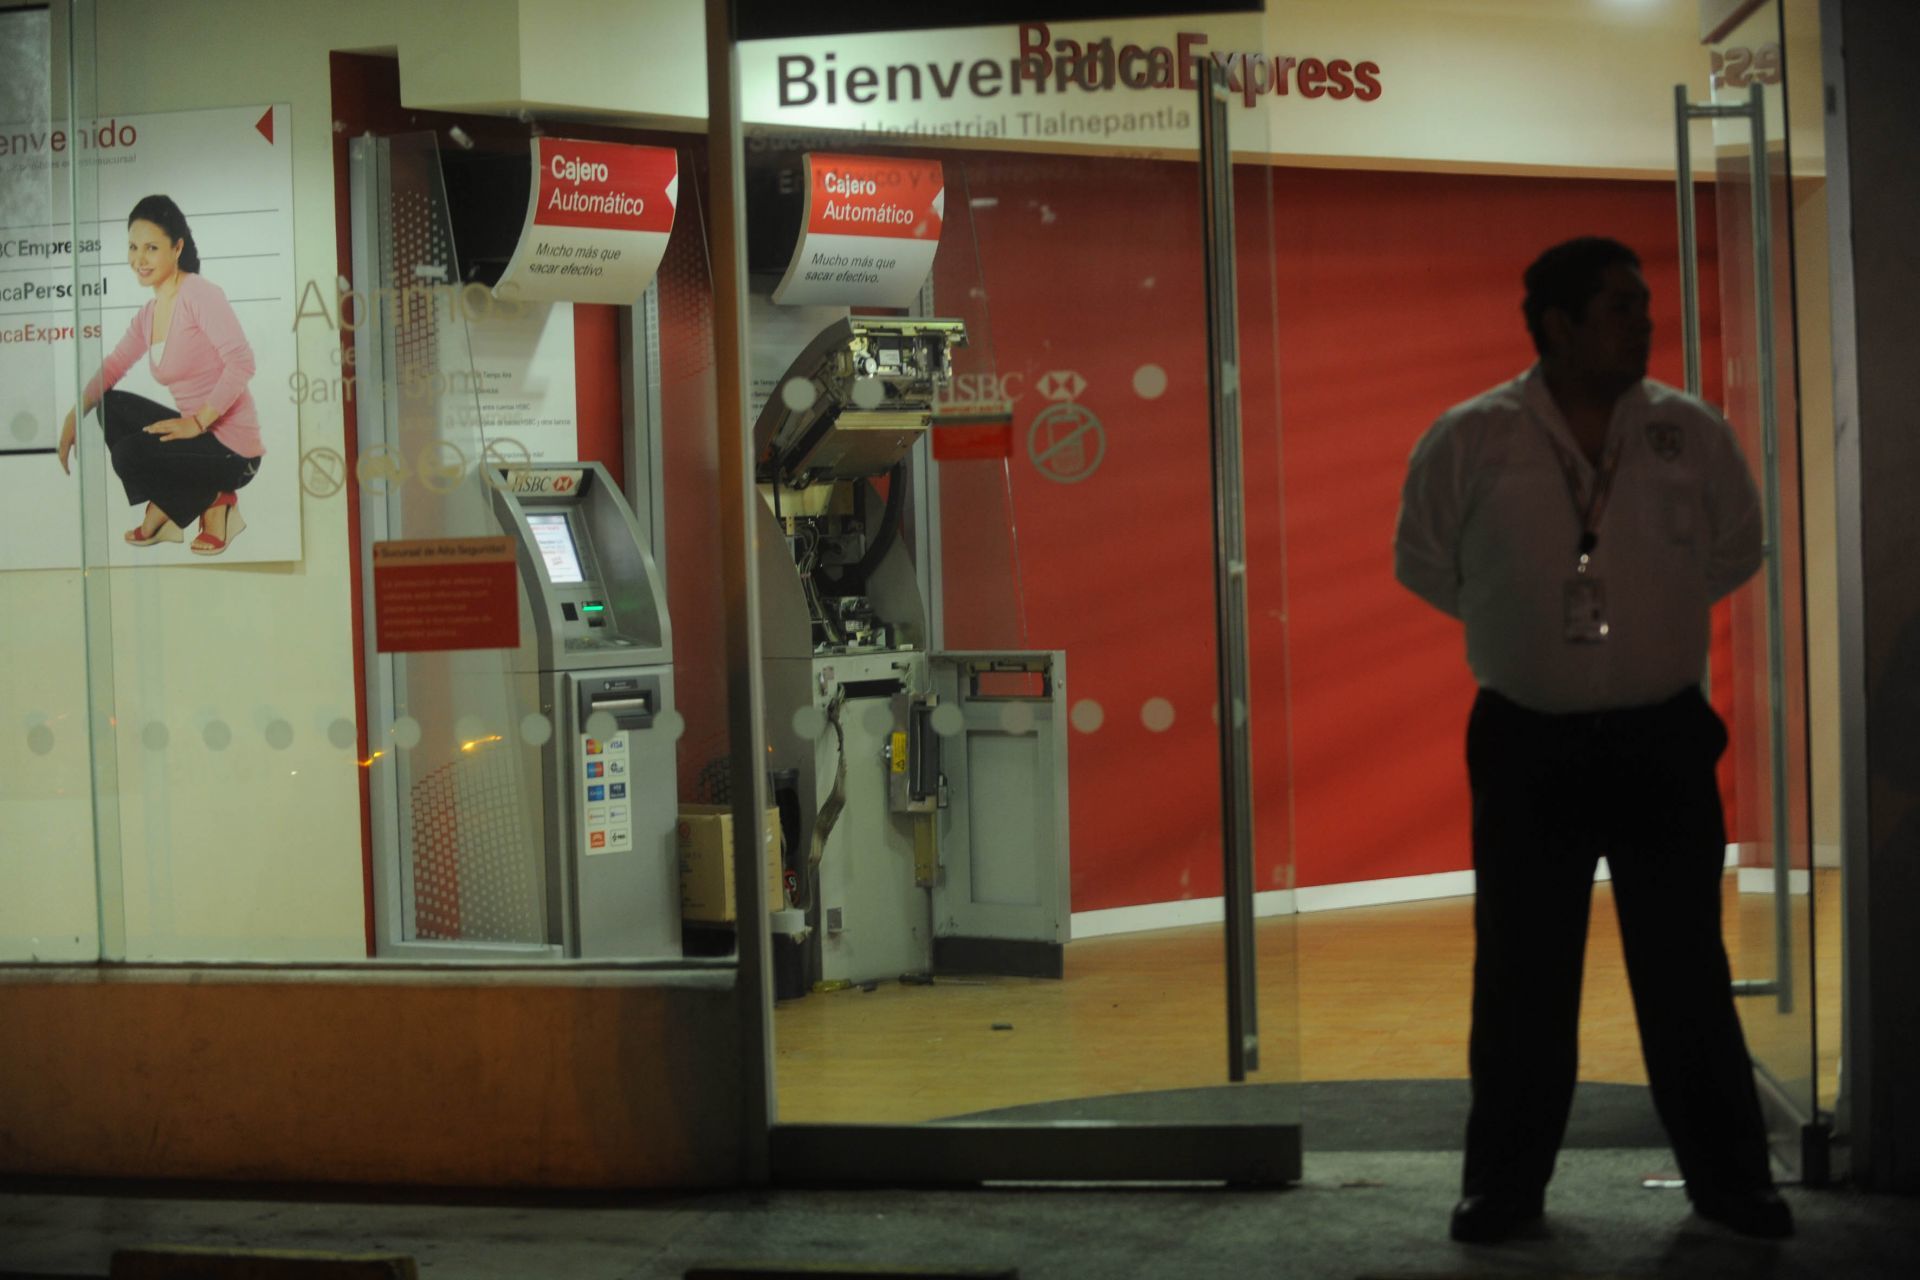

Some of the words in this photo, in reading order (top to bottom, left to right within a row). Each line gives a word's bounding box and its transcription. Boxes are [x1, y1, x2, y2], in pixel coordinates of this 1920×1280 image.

[776, 40, 1157, 108] Bienvenido
[1019, 23, 1382, 107] BancaExpress
[878, 115, 1006, 141] Industrial
[1016, 105, 1190, 138] Tlalnepantla
[551, 155, 608, 185] Cajero
[824, 172, 876, 198] Cajero
[548, 187, 644, 216] Automático
[823, 200, 914, 225] Automático
[536, 243, 573, 258] Mucho
[575, 245, 598, 259] más
[600, 248, 621, 262] que
[812, 253, 849, 267] Mucho
[850, 255, 873, 268] más
[876, 258, 896, 270] que
[529, 262, 559, 274] sacar
[560, 262, 603, 277] efectivo.
[805, 270, 834, 281] sacar
[836, 270, 879, 283] efectivo.
[0, 277, 108, 302] caPersonal
[288, 370, 365, 405] 9am
[932, 372, 1024, 402] HSBC
[512, 476, 551, 492] HSBC
